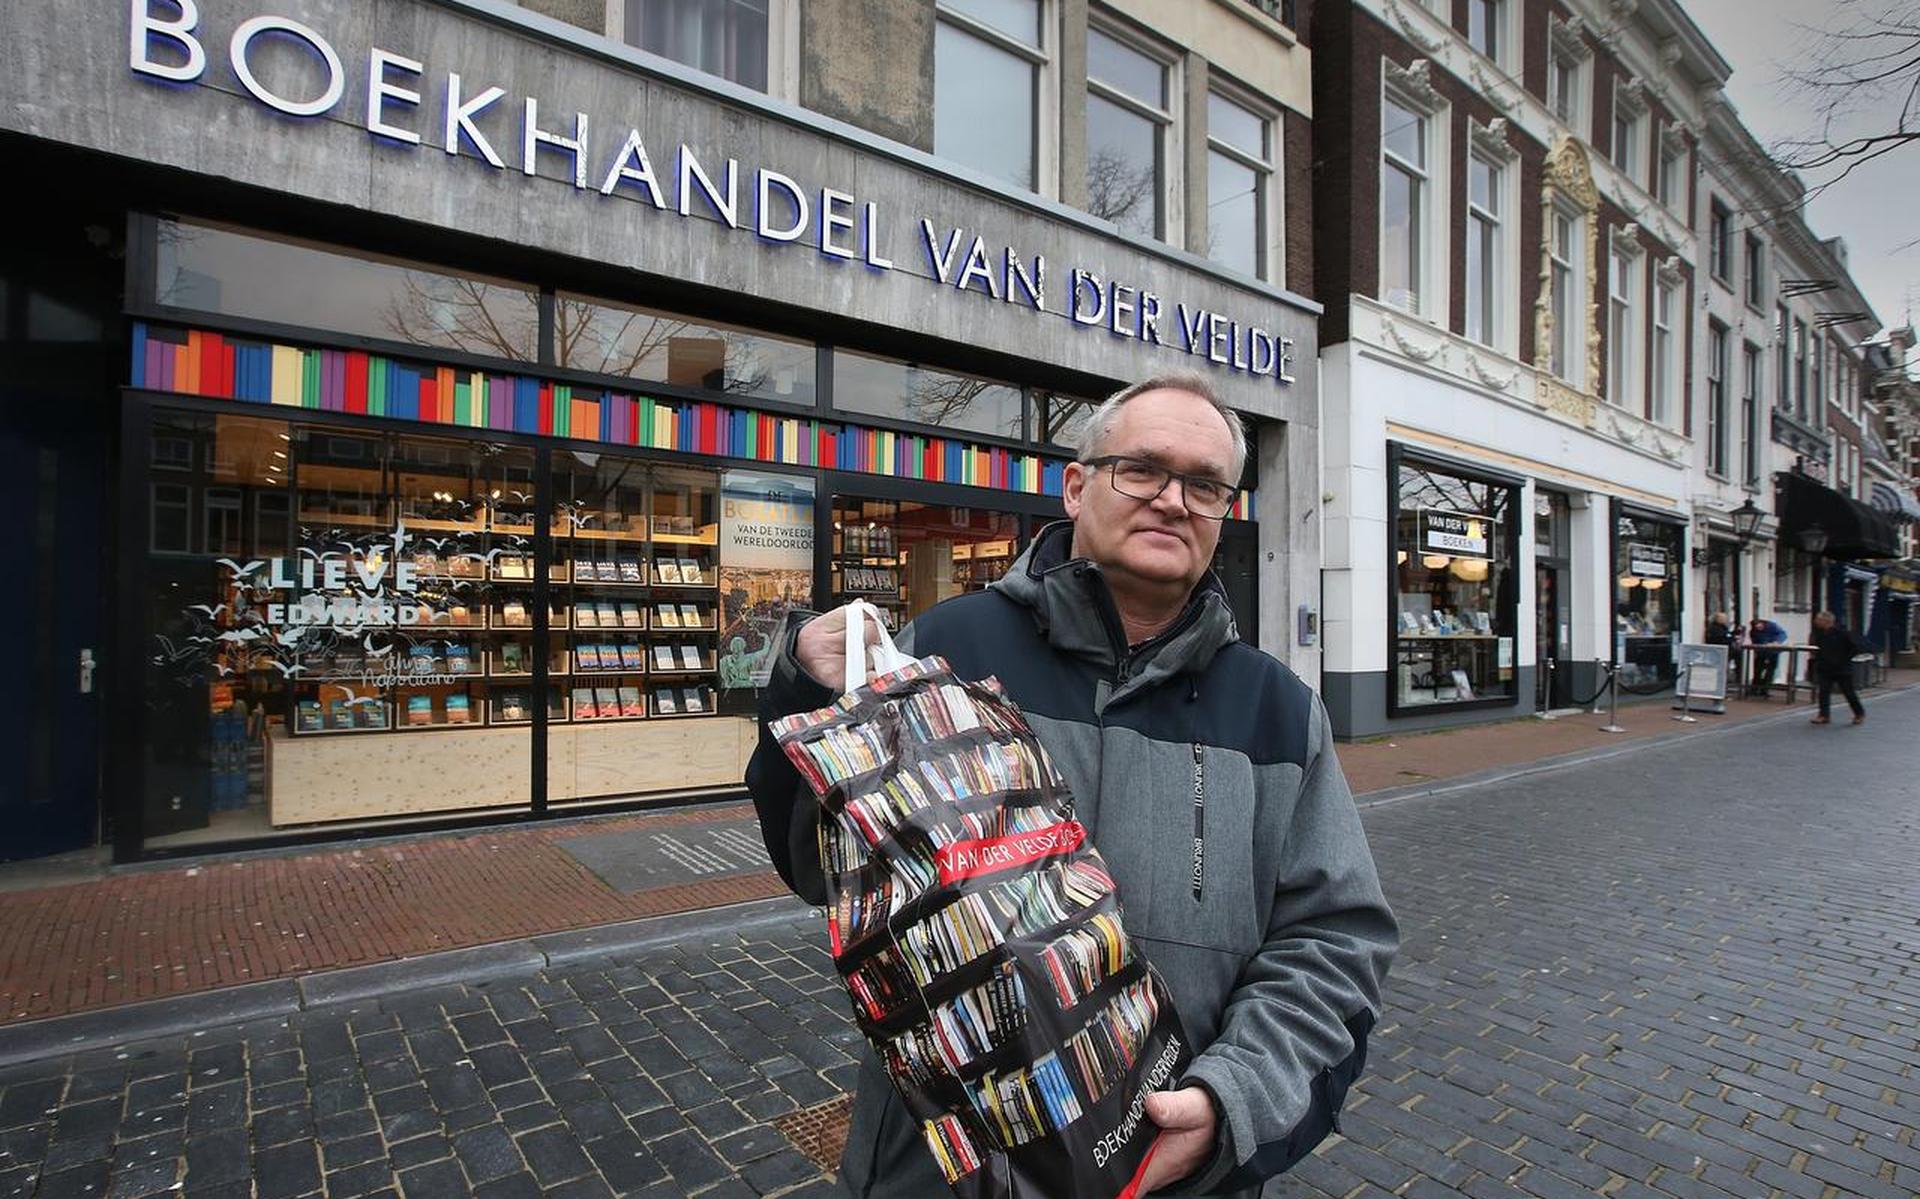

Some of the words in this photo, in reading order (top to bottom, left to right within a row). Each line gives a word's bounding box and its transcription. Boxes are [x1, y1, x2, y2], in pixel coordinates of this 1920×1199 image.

[130, 0, 893, 270] BOEKHANDEL
[923, 218, 1045, 312] VAN
[1072, 268, 1163, 345] DER
[1179, 303, 1296, 384] VELDE
[737, 524, 757, 534] VAN
[759, 525, 772, 536] DE
[774, 527, 814, 539] TWEEDE
[1428, 514, 1445, 528] VAN
[271, 557, 419, 591] LIEVE
[267, 603, 421, 625] EDWARD
[941, 847, 979, 872] VAN
[1192, 837, 1204, 890] BRUNOTTI
